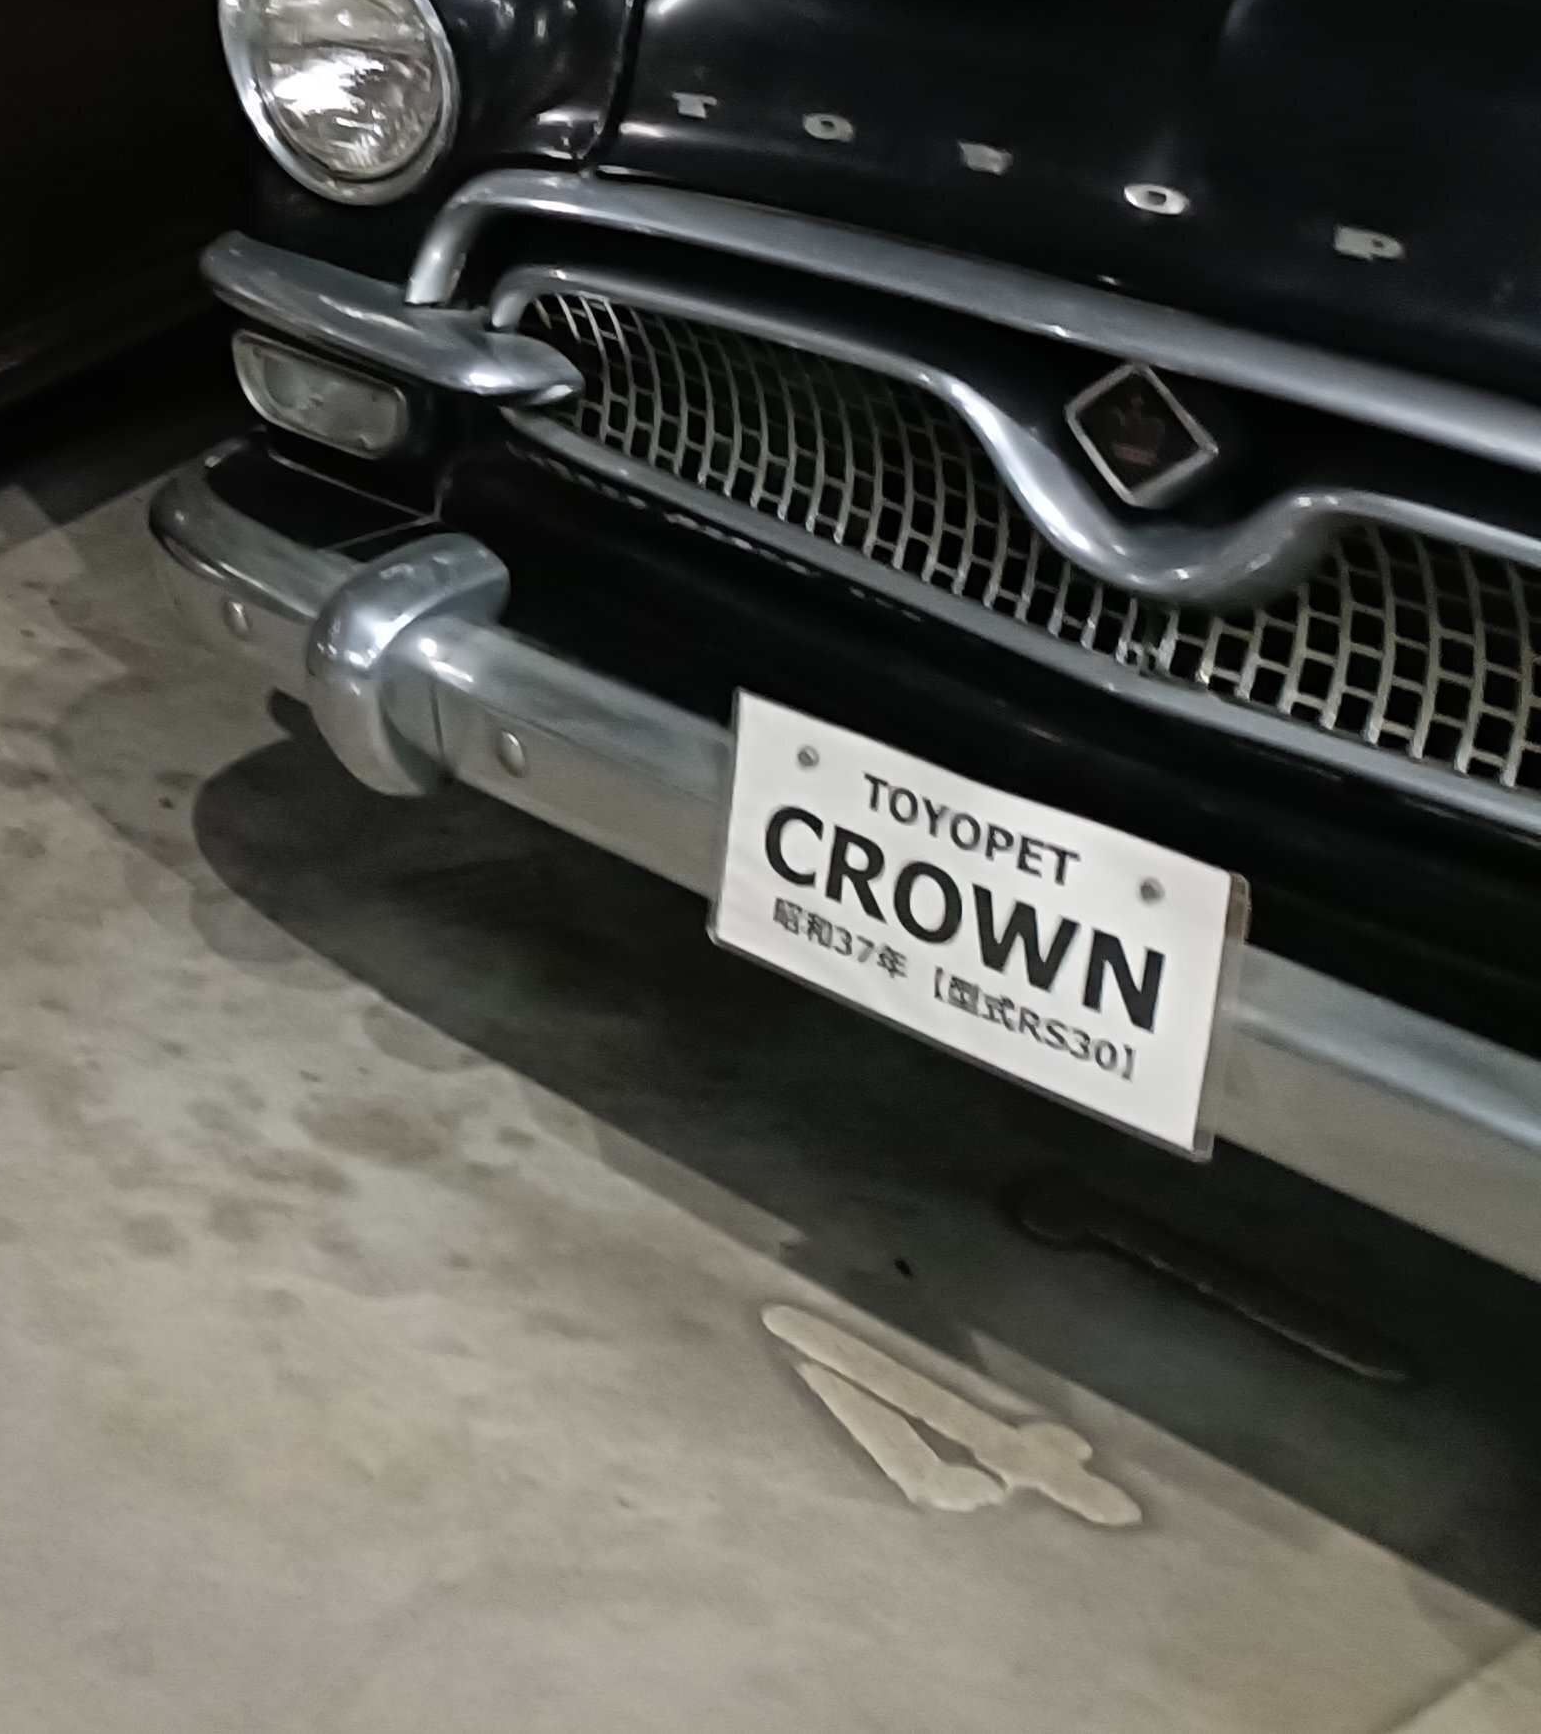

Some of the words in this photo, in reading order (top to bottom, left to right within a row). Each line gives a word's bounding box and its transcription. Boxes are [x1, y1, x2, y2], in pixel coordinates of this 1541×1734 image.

[862, 772, 1081, 887] TOYOPET
[763, 805, 1167, 1034] CROWN
[772, 896, 910, 979] 昭和37年
